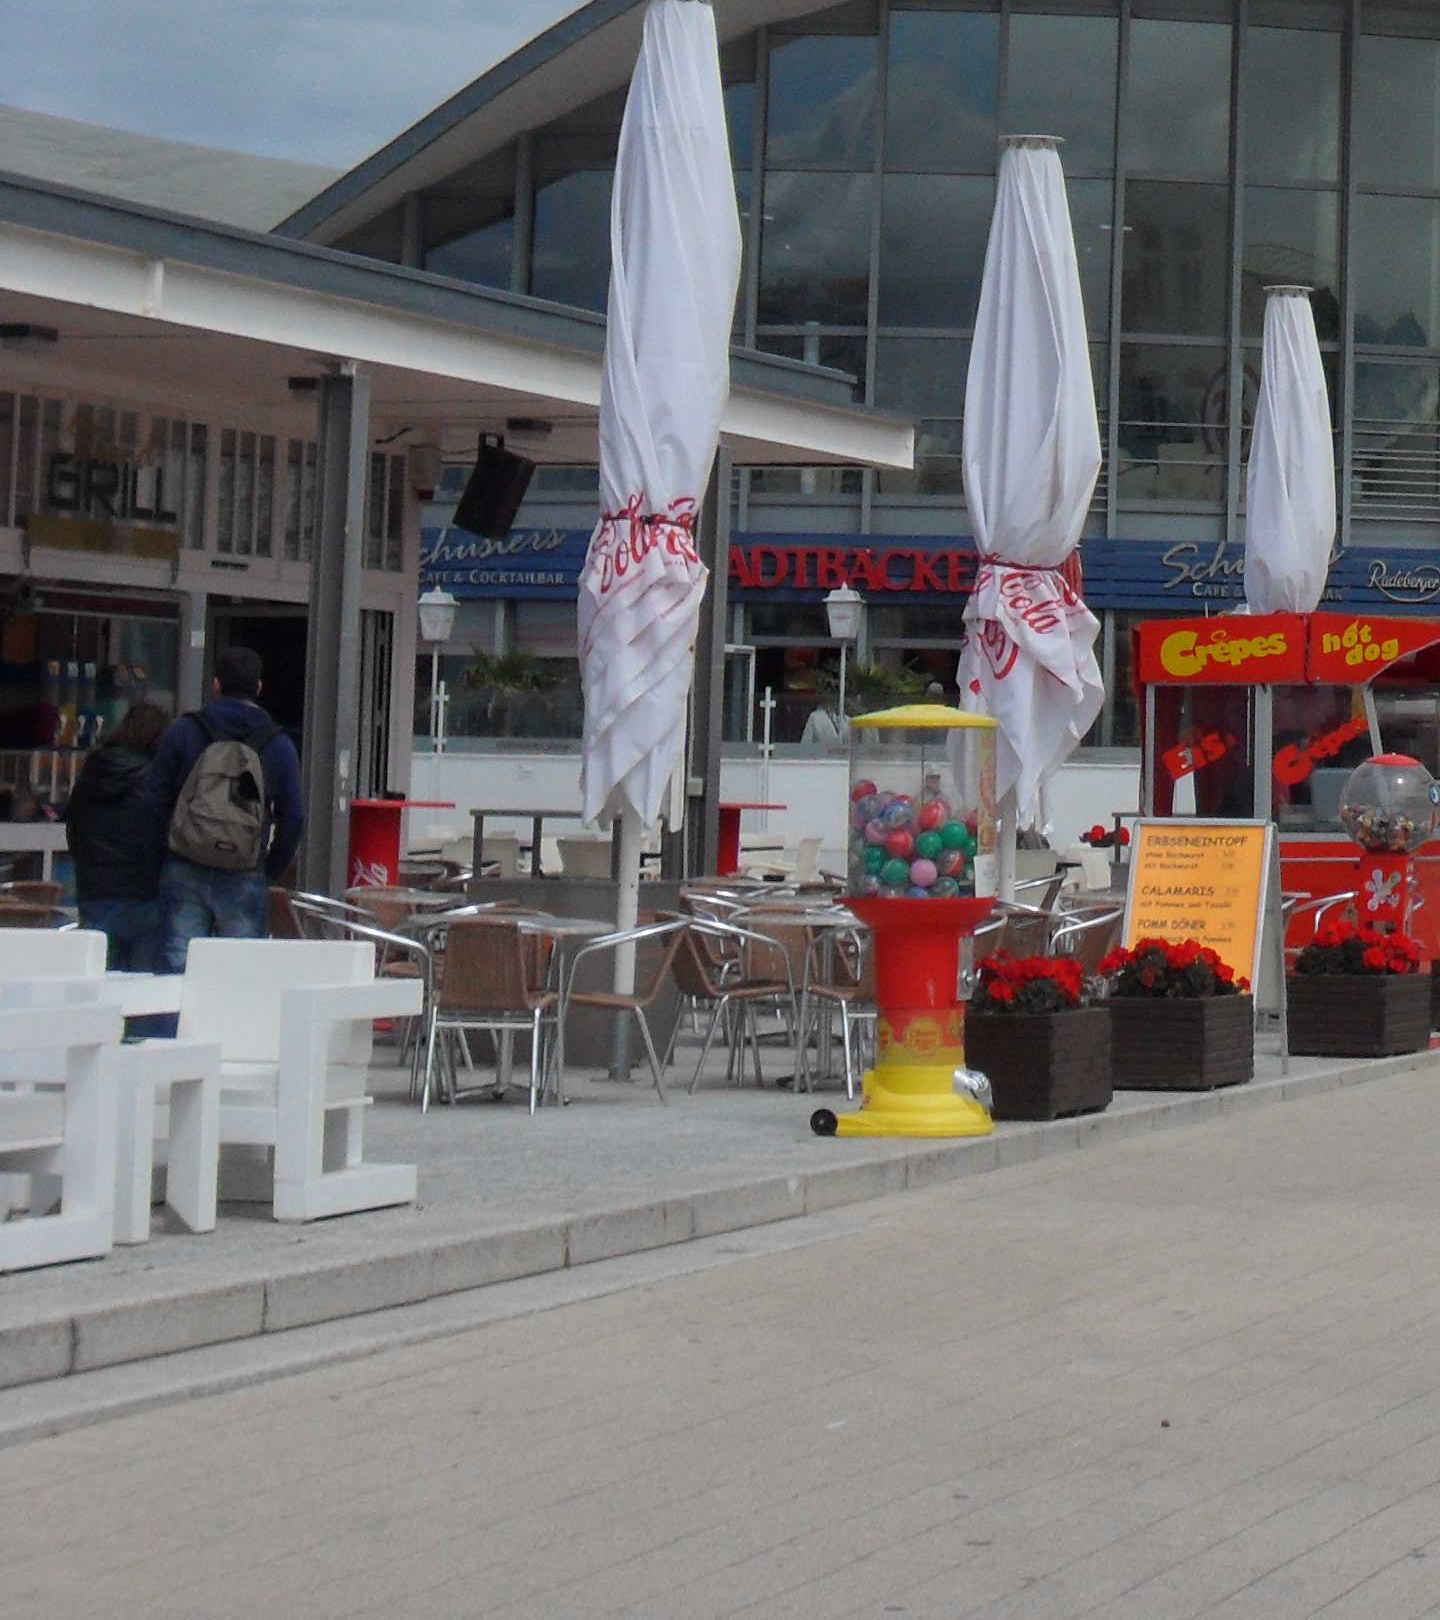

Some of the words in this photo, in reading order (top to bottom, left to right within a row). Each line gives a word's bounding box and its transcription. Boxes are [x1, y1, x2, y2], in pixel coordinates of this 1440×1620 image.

[50, 452, 178, 524] GRILL
[1322, 620, 1372, 654] hot
[1160, 630, 1287, 676] Crêpes
[1345, 638, 1399, 666] dog
[1147, 835, 1248, 848] ERBSENEINTOPF
[1141, 885, 1215, 897] CALAMARIS
[1171, 917, 1207, 930] DÖNER
